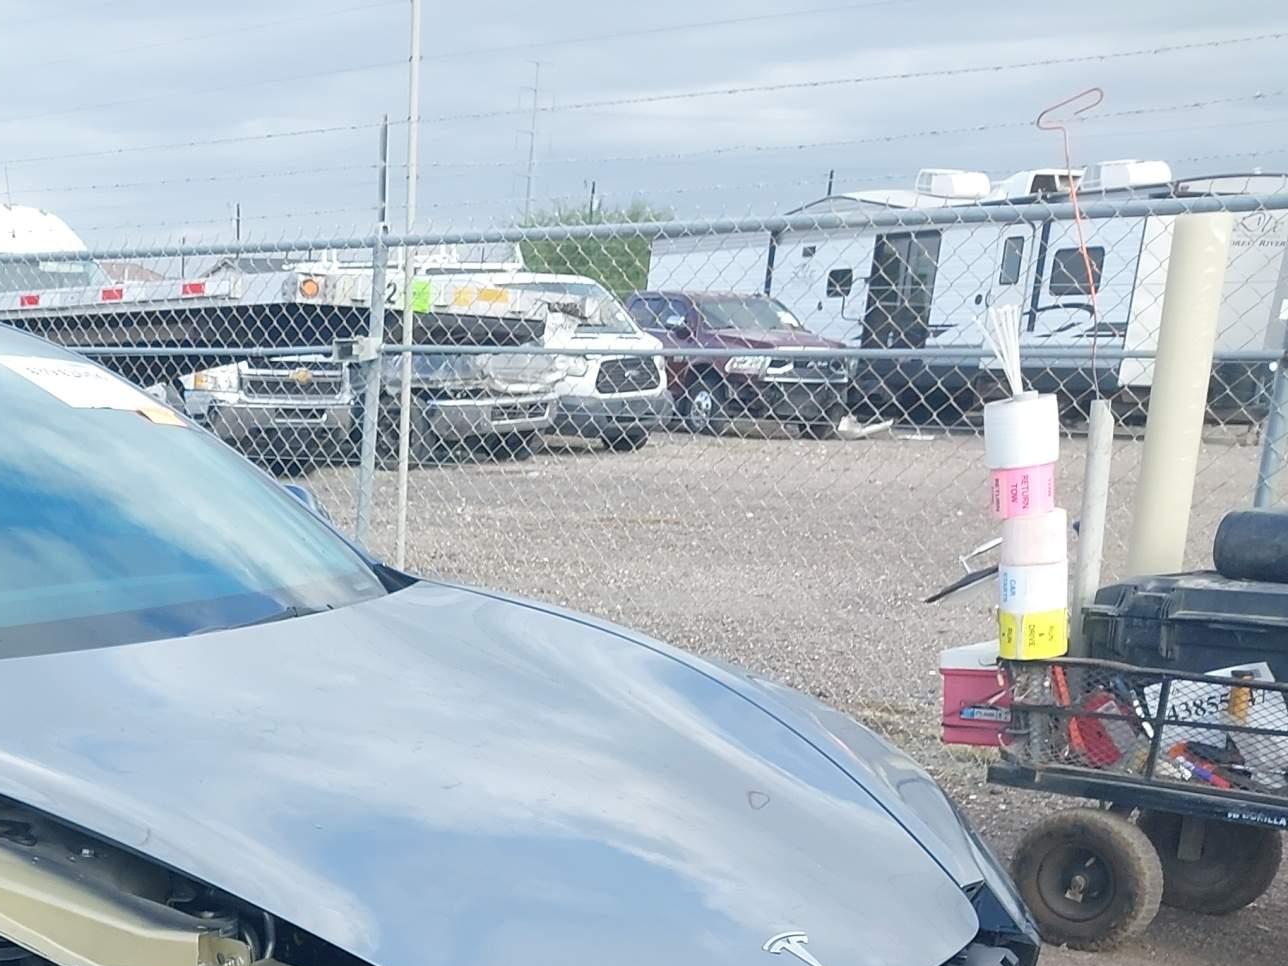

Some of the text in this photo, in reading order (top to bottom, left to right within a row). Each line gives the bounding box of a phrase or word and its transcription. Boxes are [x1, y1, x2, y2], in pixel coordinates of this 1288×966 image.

[1010, 483, 1018, 503] TOW
[1021, 473, 1030, 510] RETURN
[1028, 624, 1036, 649] DRIVE
